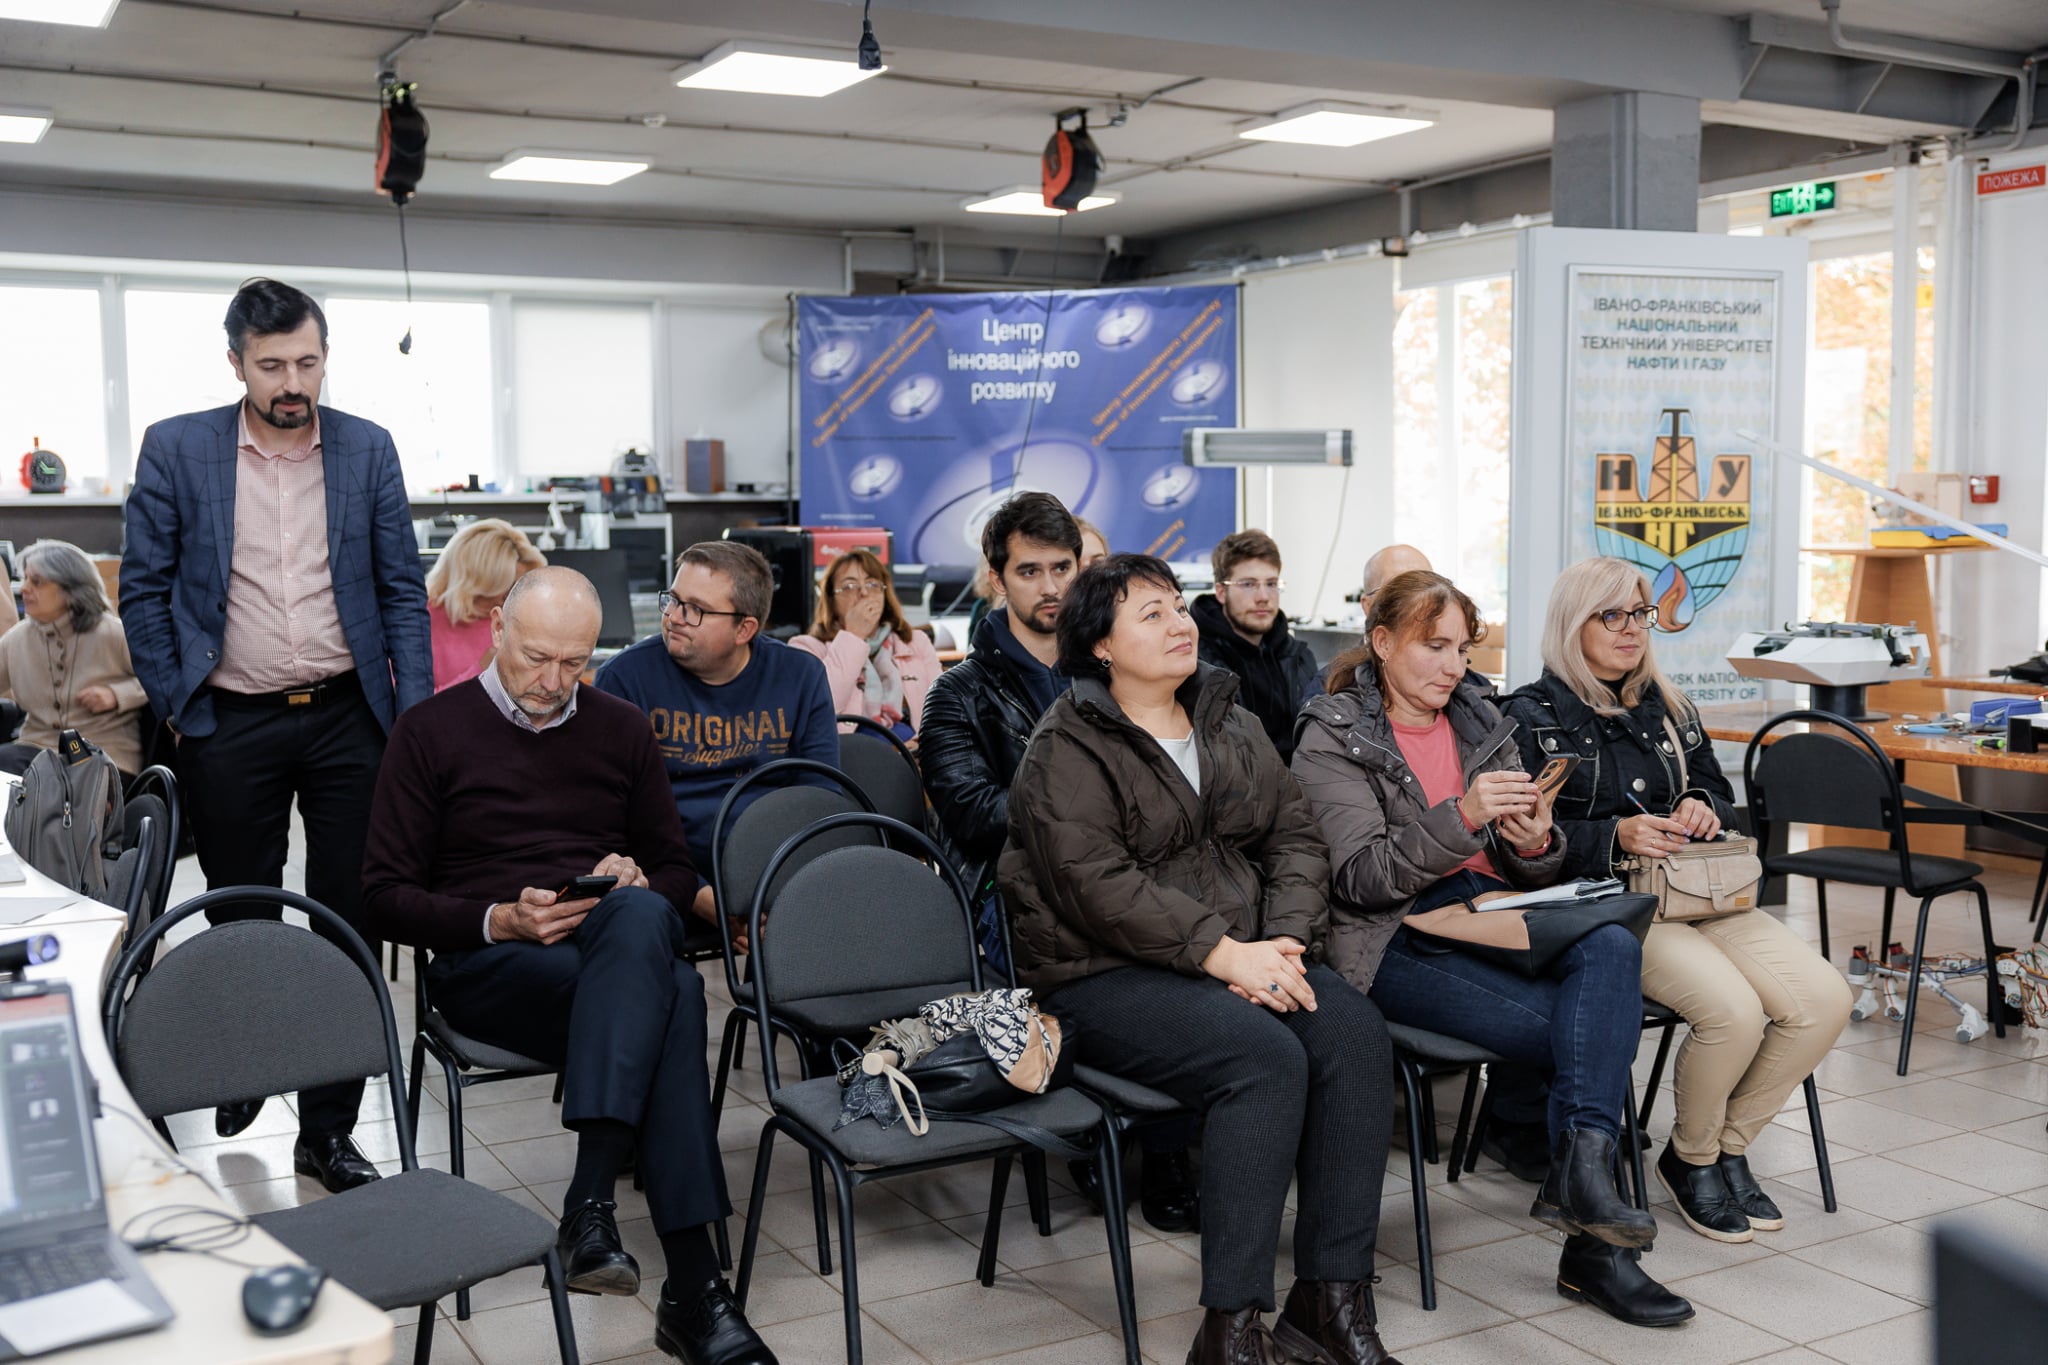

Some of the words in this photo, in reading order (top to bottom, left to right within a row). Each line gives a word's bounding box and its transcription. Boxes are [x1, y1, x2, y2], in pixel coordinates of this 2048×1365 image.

[1983, 169, 2040, 191] ПОЖЕЖА
[1593, 298, 1762, 314] ІВАНО-ФРАНКІВСЬКИЙ
[982, 318, 1044, 346] Центр
[1617, 317, 1738, 333] НАЦІОНАЛЬНИЙ
[1581, 335, 1667, 350] ТЕХНІЧНИЙ
[1672, 338, 1772, 353] УНІВЕРСИТЕТ
[947, 347, 1080, 375] інноваційного
[1626, 356, 1679, 370] НАФТИ
[1693, 356, 1728, 371] ГАЗУ
[970, 380, 1057, 404] розвитку
[1598, 505, 1746, 519] ІВАНО-ФРАНКІВСЬК
[1740, 688, 1757, 700] OF
[650, 708, 792, 746] ORIGINAL
